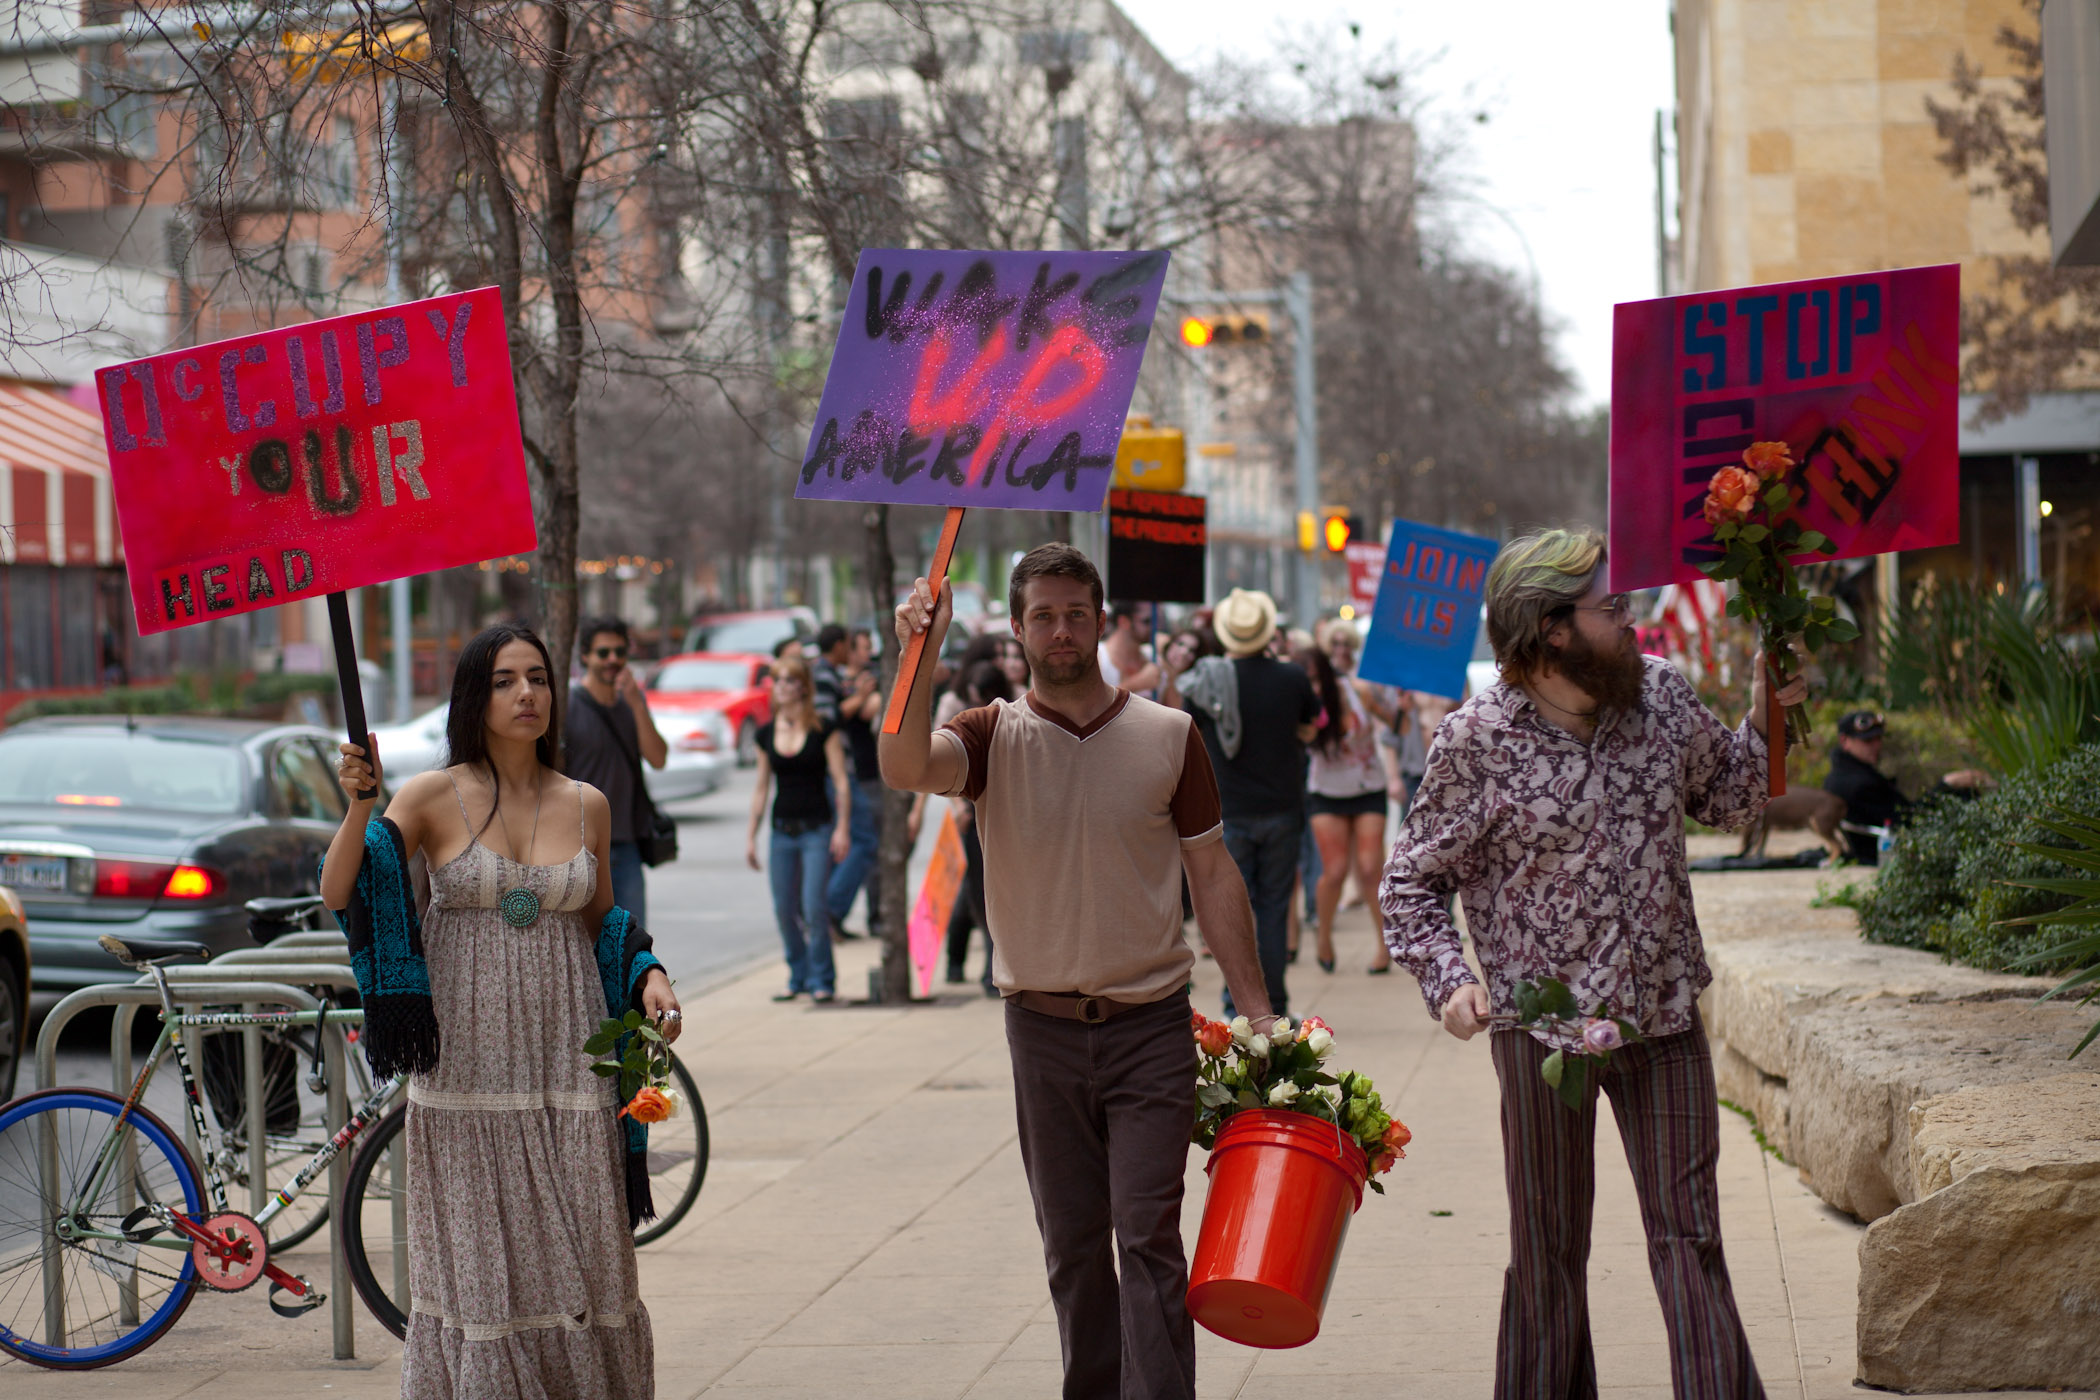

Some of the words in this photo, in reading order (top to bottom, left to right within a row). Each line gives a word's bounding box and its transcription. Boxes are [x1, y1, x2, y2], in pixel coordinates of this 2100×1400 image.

[866, 253, 1164, 351] WAKE
[1683, 283, 1882, 394] STOP
[104, 302, 473, 453] OCCUPY
[908, 323, 1106, 487] UP
[218, 419, 432, 518] YOUR
[161, 548, 314, 621] HEAD
[1389, 541, 1486, 594] JOIN
[1403, 595, 1458, 636] US
